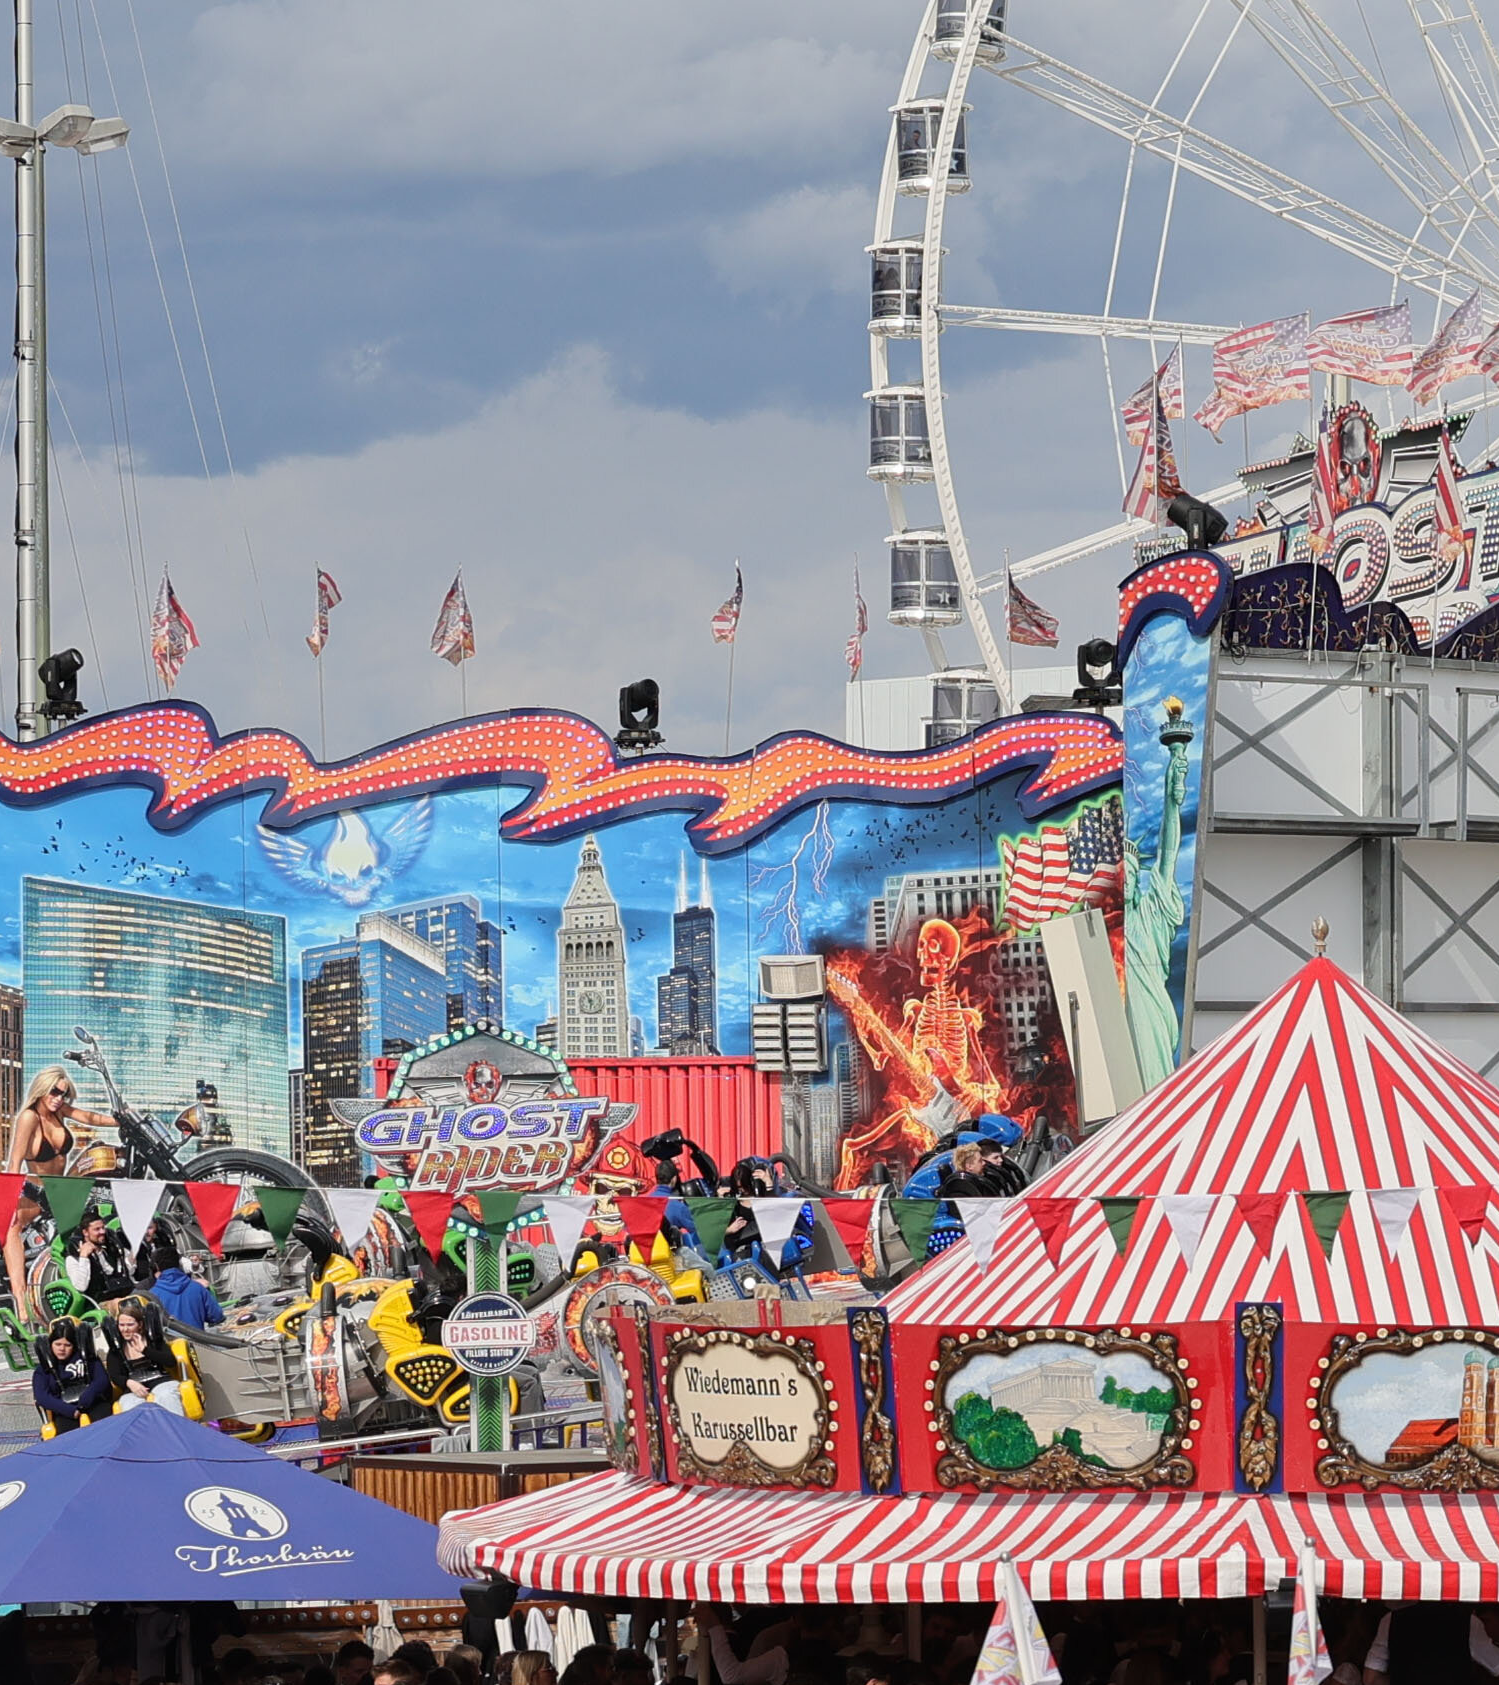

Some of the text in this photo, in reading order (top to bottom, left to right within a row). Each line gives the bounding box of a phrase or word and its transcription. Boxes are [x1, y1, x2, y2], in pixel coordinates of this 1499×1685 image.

[359, 1101, 600, 1145] GHOST
[418, 1142, 568, 1194] RIDER
[449, 1324, 529, 1344] GASOLINE
[465, 1348, 514, 1358] FILLING STATION
[691, 1411, 799, 1442] Karussellbar
[175, 1544, 355, 1573] Thorbräu
